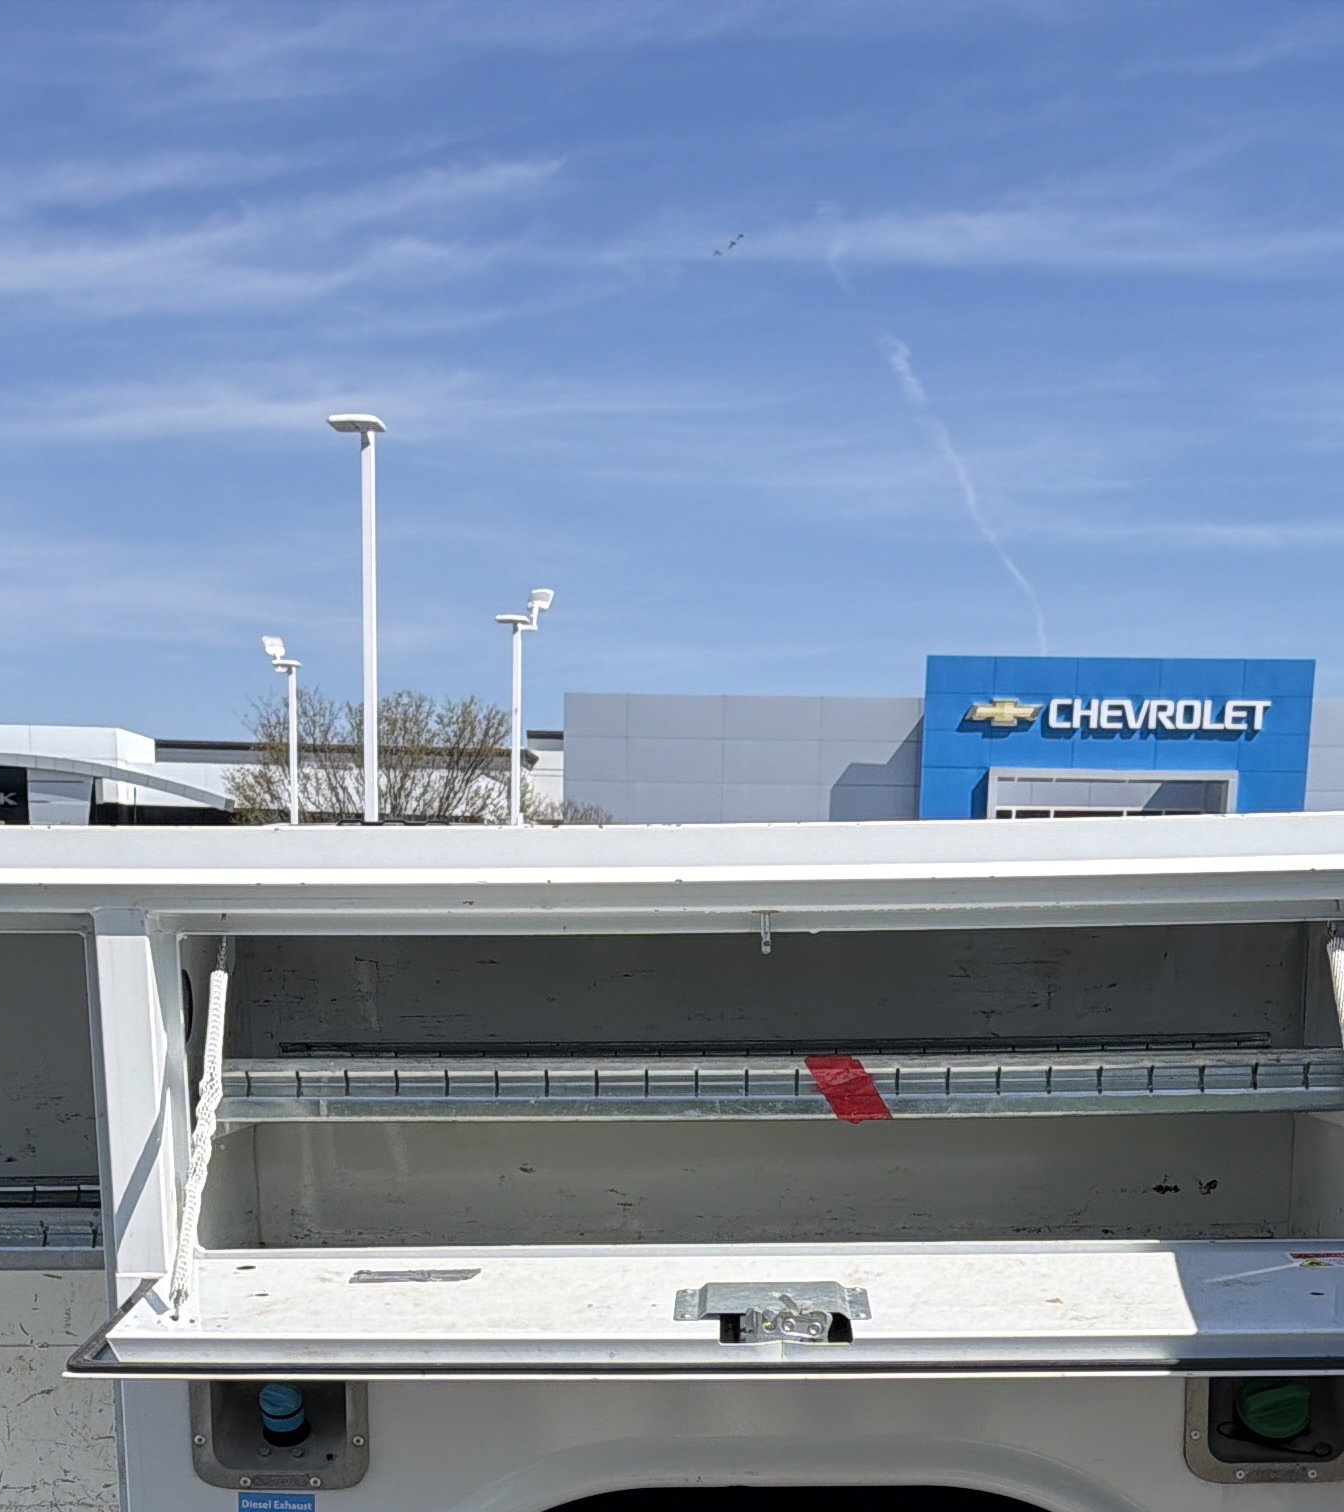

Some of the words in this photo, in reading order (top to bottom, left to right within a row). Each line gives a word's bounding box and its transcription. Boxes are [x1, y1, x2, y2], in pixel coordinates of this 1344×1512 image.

[1048, 698, 1271, 731] CHEVROLET
[241, 1499, 272, 1510] Diesel
[273, 1499, 313, 1511] Exhaust
